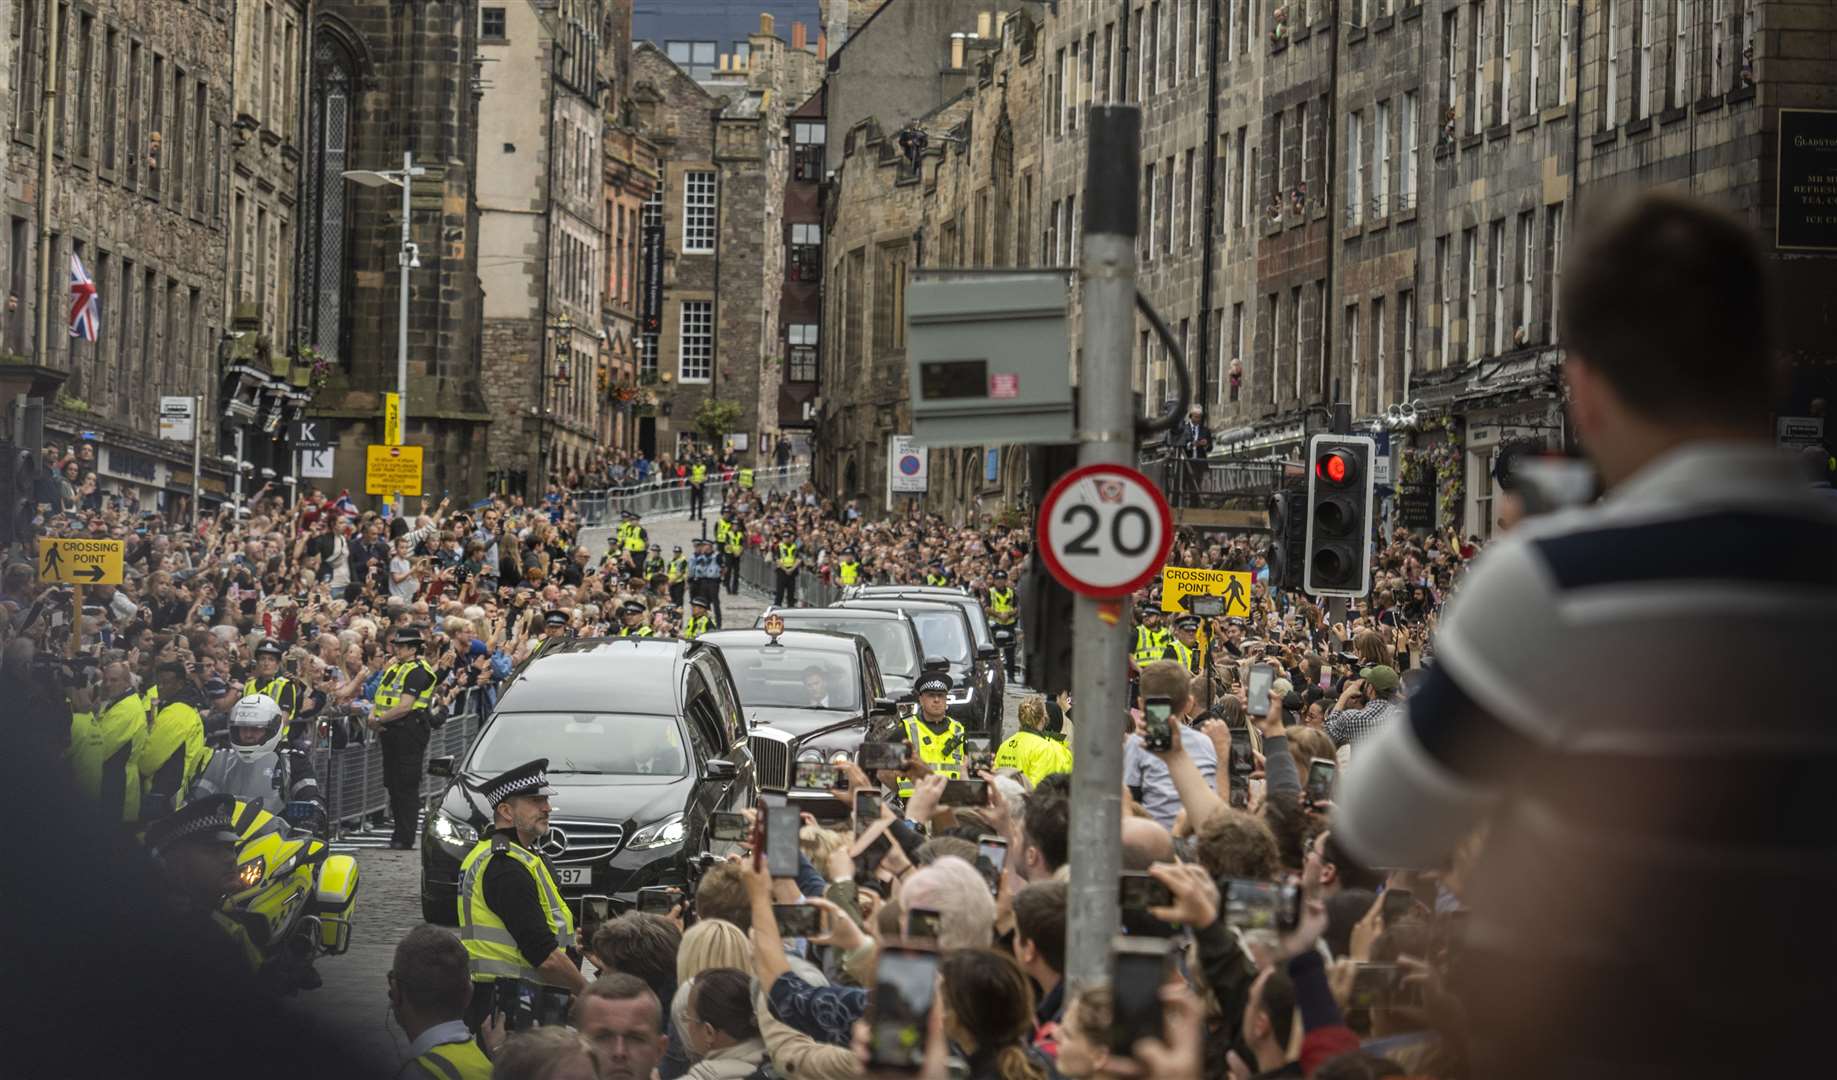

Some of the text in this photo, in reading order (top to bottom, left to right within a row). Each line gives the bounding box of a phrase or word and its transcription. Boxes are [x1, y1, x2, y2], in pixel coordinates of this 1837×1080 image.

[301, 423, 316, 441] K
[311, 450, 325, 468] K
[1061, 504, 1153, 558] 20
[63, 542, 119, 553] CROSSING
[73, 554, 106, 564] POINT
[1166, 569, 1224, 582] CROSSING
[1177, 582, 1210, 592] POINT
